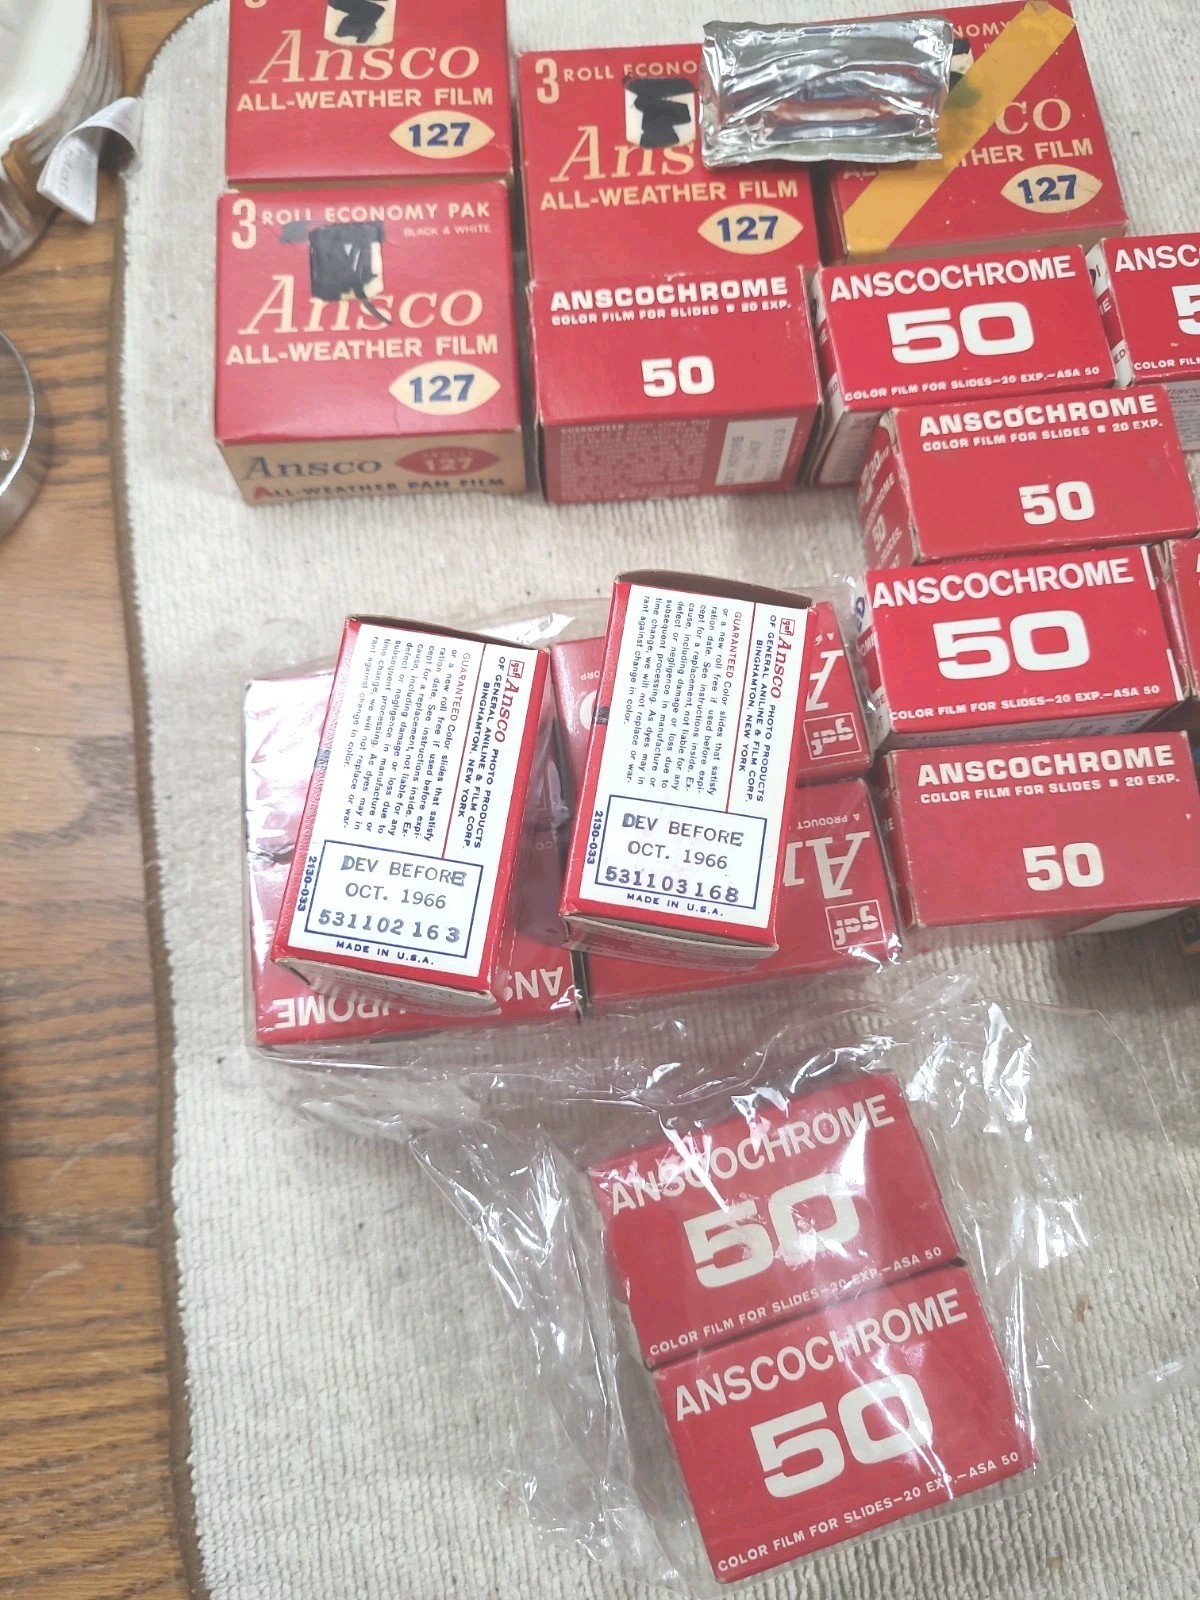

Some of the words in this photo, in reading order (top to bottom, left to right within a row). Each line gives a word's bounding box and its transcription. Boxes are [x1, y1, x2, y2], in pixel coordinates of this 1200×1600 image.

[249, 30, 479, 84] Ansco
[535, 58, 560, 104] 3
[564, 66, 614, 82] ROLL
[624, 60, 697, 77] ECONO
[237, 89, 422, 112] ALL-WEATHER
[435, 87, 493, 107] FILM
[408, 122, 471, 148] 127
[1034, 138, 1093, 160] FILM
[550, 125, 696, 183] Ans
[541, 182, 726, 211] ALL-WEATHER
[739, 180, 798, 200] FILM
[1018, 174, 1077, 204] 127
[232, 198, 256, 249] 3
[325, 203, 438, 223] ECONOMY
[449, 202, 490, 218] PAK
[404, 227, 439, 238] BLACK
[442, 226, 450, 236] &
[454, 224, 491, 235] WHITE
[716, 215, 779, 242] 127
[550, 276, 788, 312] ANSCOCHROME
[830, 255, 1076, 302] ANSCOCHROME
[238, 275, 482, 335] Ansco
[552, 312, 597, 326] COLOR
[602, 309, 635, 323] FILM
[639, 308, 666, 320] FOR
[671, 305, 719, 318] SLIDES
[741, 301, 758, 313] 20
[761, 299, 792, 312] EXP.
[887, 301, 1035, 364] 50
[226, 338, 422, 365] ALL-WEATHER
[435, 334, 498, 355] FILM
[1134, 358, 1176, 371] COLOR
[409, 373, 475, 404] 127
[641, 355, 716, 398] 50
[844, 387, 887, 402] COLOR
[891, 383, 918, 397] FILM
[922, 380, 947, 393] FOR
[1085, 366, 1100, 377] 50
[919, 394, 1158, 437] ANSCOCHROME
[922, 438, 969, 452] COLOR
[972, 434, 1005, 448] FILM
[1010, 431, 1037, 443] FOR
[1041, 427, 1090, 441] SLIDES
[1112, 422, 1129, 433] 20
[1133, 418, 1163, 431] EXP.
[242, 455, 382, 481] Ansco
[425, 457, 473, 471] 127
[1018, 480, 1095, 525] 50
[873, 558, 1134, 608] ANSCOCHROME
[722, 608, 729, 617] or
[769, 614, 777, 628] OF
[717, 631, 726, 650] new
[725, 611, 742, 678] GUARANTEED
[761, 631, 775, 679] GENERAL
[932, 610, 1091, 681] 50
[497, 656, 506, 671] OF
[714, 654, 723, 669] roll
[770, 635, 792, 699] Ansco
[449, 652, 471, 722] GUARANTEED
[711, 673, 721, 692] free
[721, 680, 732, 706] Color
[486, 674, 502, 723] GENERAL
[494, 677, 520, 743] Ansco
[709, 696, 718, 704] if
[755, 682, 767, 725] ANILINE
[890, 706, 934, 721] COLOR
[938, 703, 967, 716] FILM
[971, 700, 996, 713] FOR
[1143, 684, 1160, 696] 50
[705, 709, 714, 732] used
[716, 710, 727, 737] slides
[743, 714, 753, 739] NEW
[754, 728, 762, 737] &
[764, 704, 776, 740] PHOTO
[443, 724, 456, 750] Color
[477, 726, 492, 770] ANILINE
[700, 735, 712, 765] before
[712, 742, 723, 761] that
[750, 740, 760, 765] FILM
[436, 754, 449, 782] slides
[464, 758, 475, 784] NEW
[486, 748, 499, 785] PHOTO
[738, 743, 749, 772] YORK
[756, 744, 771, 802] PRODUCTS
[917, 745, 1175, 787] ANSCOCHROME
[475, 773, 483, 781] &
[706, 765, 720, 796] satisfy
[745, 769, 756, 802] CORP.
[920, 790, 971, 804] COLOR
[975, 786, 1011, 800] FILM
[1015, 784, 1044, 796] FOR
[1048, 780, 1101, 793] SLIDES
[1125, 775, 1144, 787] 20
[1148, 773, 1180, 785] EXP.
[431, 787, 443, 806] that
[457, 788, 470, 817] YORK
[469, 785, 481, 811] FILM
[423, 810, 437, 842] satisfy
[462, 815, 475, 848] CORP.
[473, 789, 491, 848] PRODUCTS
[621, 812, 659, 831] DEV
[668, 820, 744, 847] BEFORE
[797, 815, 848, 830] PRODUCT
[587, 810, 604, 865] 2130-033
[627, 840, 670, 860] OCT.
[682, 849, 728, 869] 1966
[1022, 842, 1105, 892] 50
[297, 855, 318, 912] 2130-033
[339, 854, 379, 873] DEV
[388, 861, 467, 887] BEFORE
[344, 882, 388, 901] OCT.
[400, 888, 446, 909] 1966
[626, 892, 659, 905] MADE
[666, 899, 679, 908] IN
[686, 902, 723, 916] U.S.A.
[335, 940, 370, 953] MADE
[376, 948, 389, 957] IN
[396, 951, 434, 965] U.S.A.
[683, 1172, 861, 1289] 50
[649, 1330, 698, 1356] COLOR
[704, 1318, 735, 1338] FILM
[738, 1306, 766, 1328] FOR
[925, 1246, 942, 1261] 50
[676, 1288, 968, 1421] ANSCOCHROME
[750, 1373, 934, 1498] 50
[718, 1544, 769, 1572] COLOR
[773, 1529, 805, 1552] FILM
[809, 1516, 839, 1537] FOR
[1001, 1451, 1019, 1466] 50
